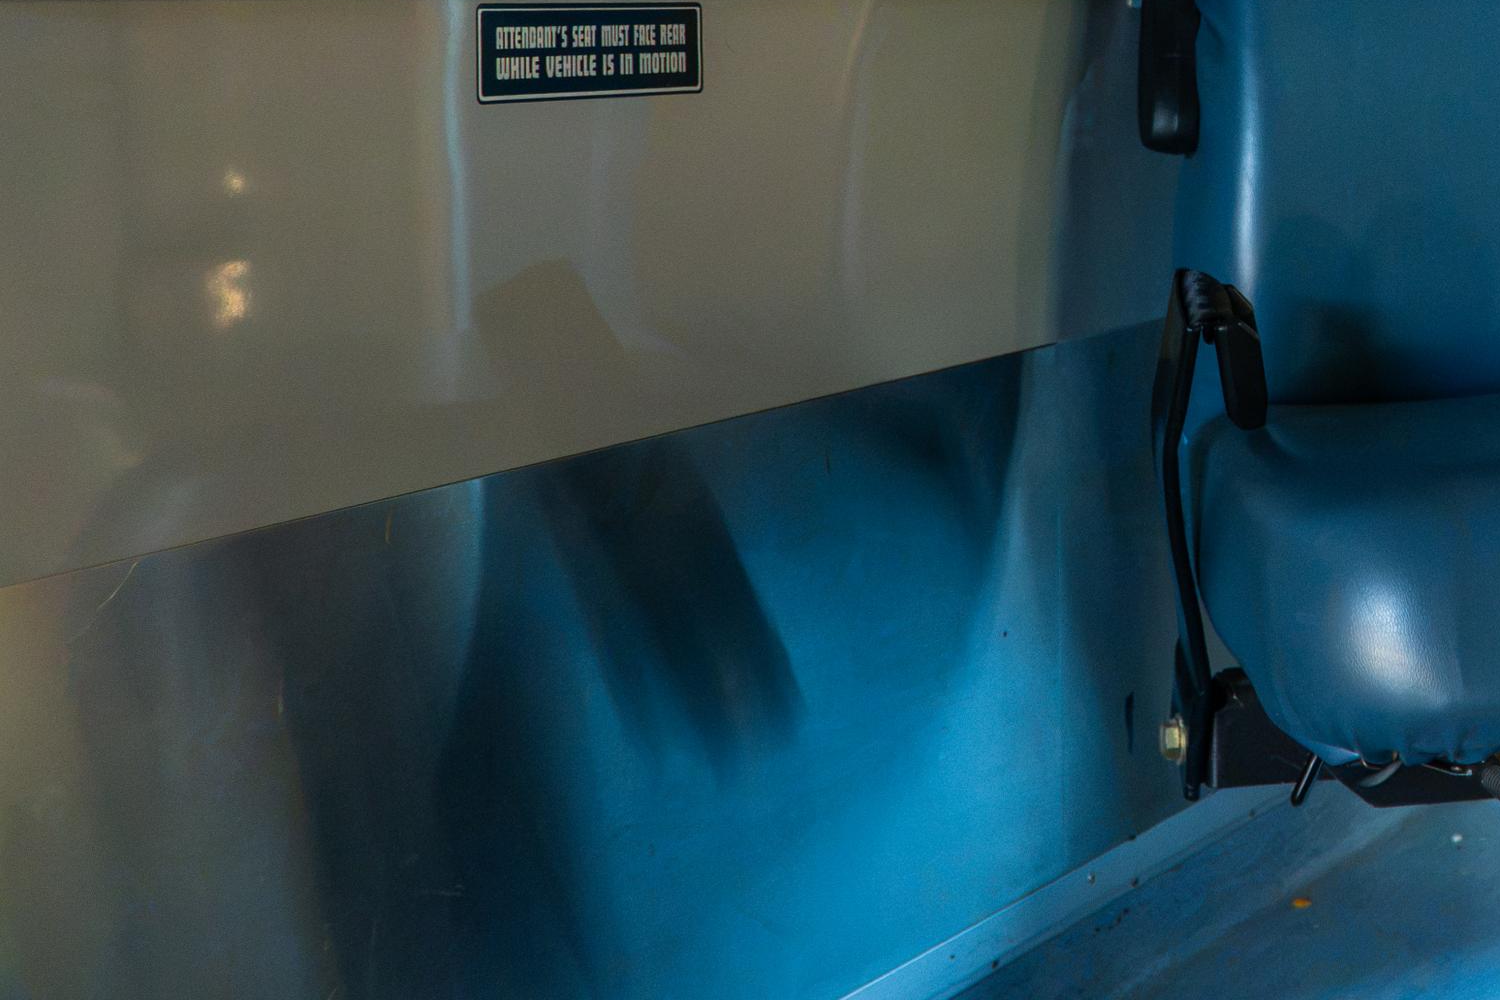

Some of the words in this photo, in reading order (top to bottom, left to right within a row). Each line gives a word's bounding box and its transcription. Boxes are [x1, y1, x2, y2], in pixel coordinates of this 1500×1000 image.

[495, 25, 568, 50] ATTENDANT'S
[572, 24, 597, 48] SEAT
[601, 24, 629, 47] MUST
[634, 23, 656, 46] FACE
[660, 23, 686, 45] REAR
[495, 56, 540, 81] WHILE
[545, 54, 597, 78] VEHICLE
[602, 53, 615, 76] IS
[620, 53, 634, 75] IN
[639, 51, 687, 74] MOTION
